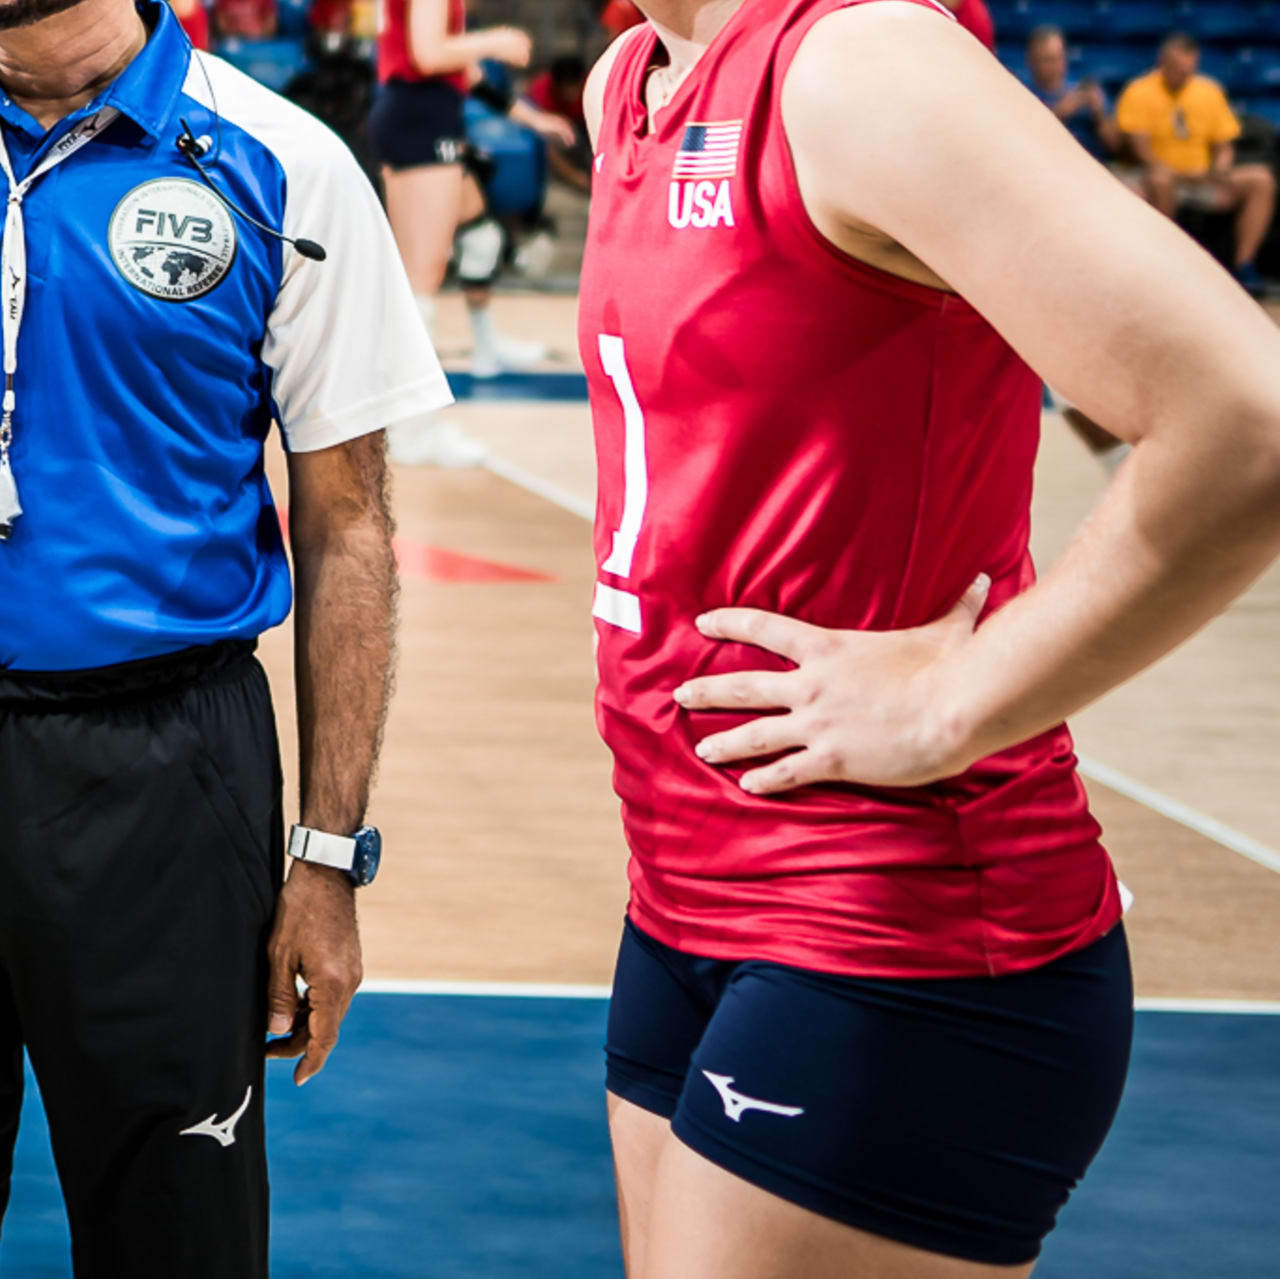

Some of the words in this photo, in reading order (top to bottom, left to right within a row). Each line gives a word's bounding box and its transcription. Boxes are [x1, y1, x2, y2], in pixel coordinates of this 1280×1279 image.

[135, 208, 214, 243] FIVB
[668, 180, 735, 229] USA
[597, 333, 648, 579] 1
